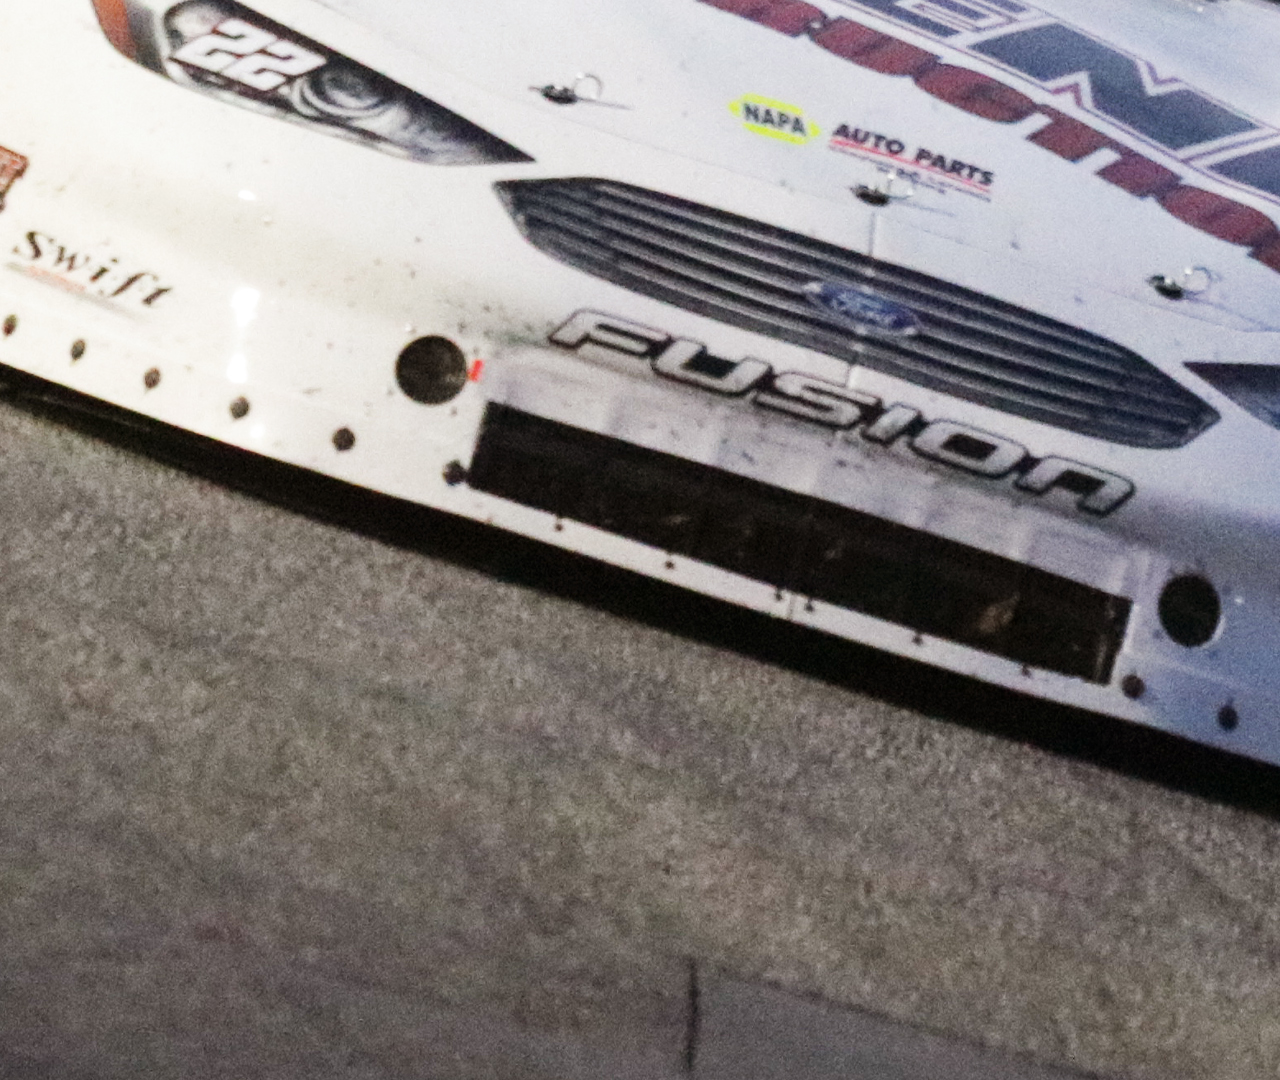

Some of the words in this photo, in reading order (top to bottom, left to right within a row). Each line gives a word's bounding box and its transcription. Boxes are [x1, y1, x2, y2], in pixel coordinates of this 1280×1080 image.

[172, 18, 328, 92] 22
[742, 103, 807, 137] NAPA
[833, 123, 905, 155] AUTO
[916, 147, 994, 187] PARTS
[547, 307, 1135, 517] FUSION
